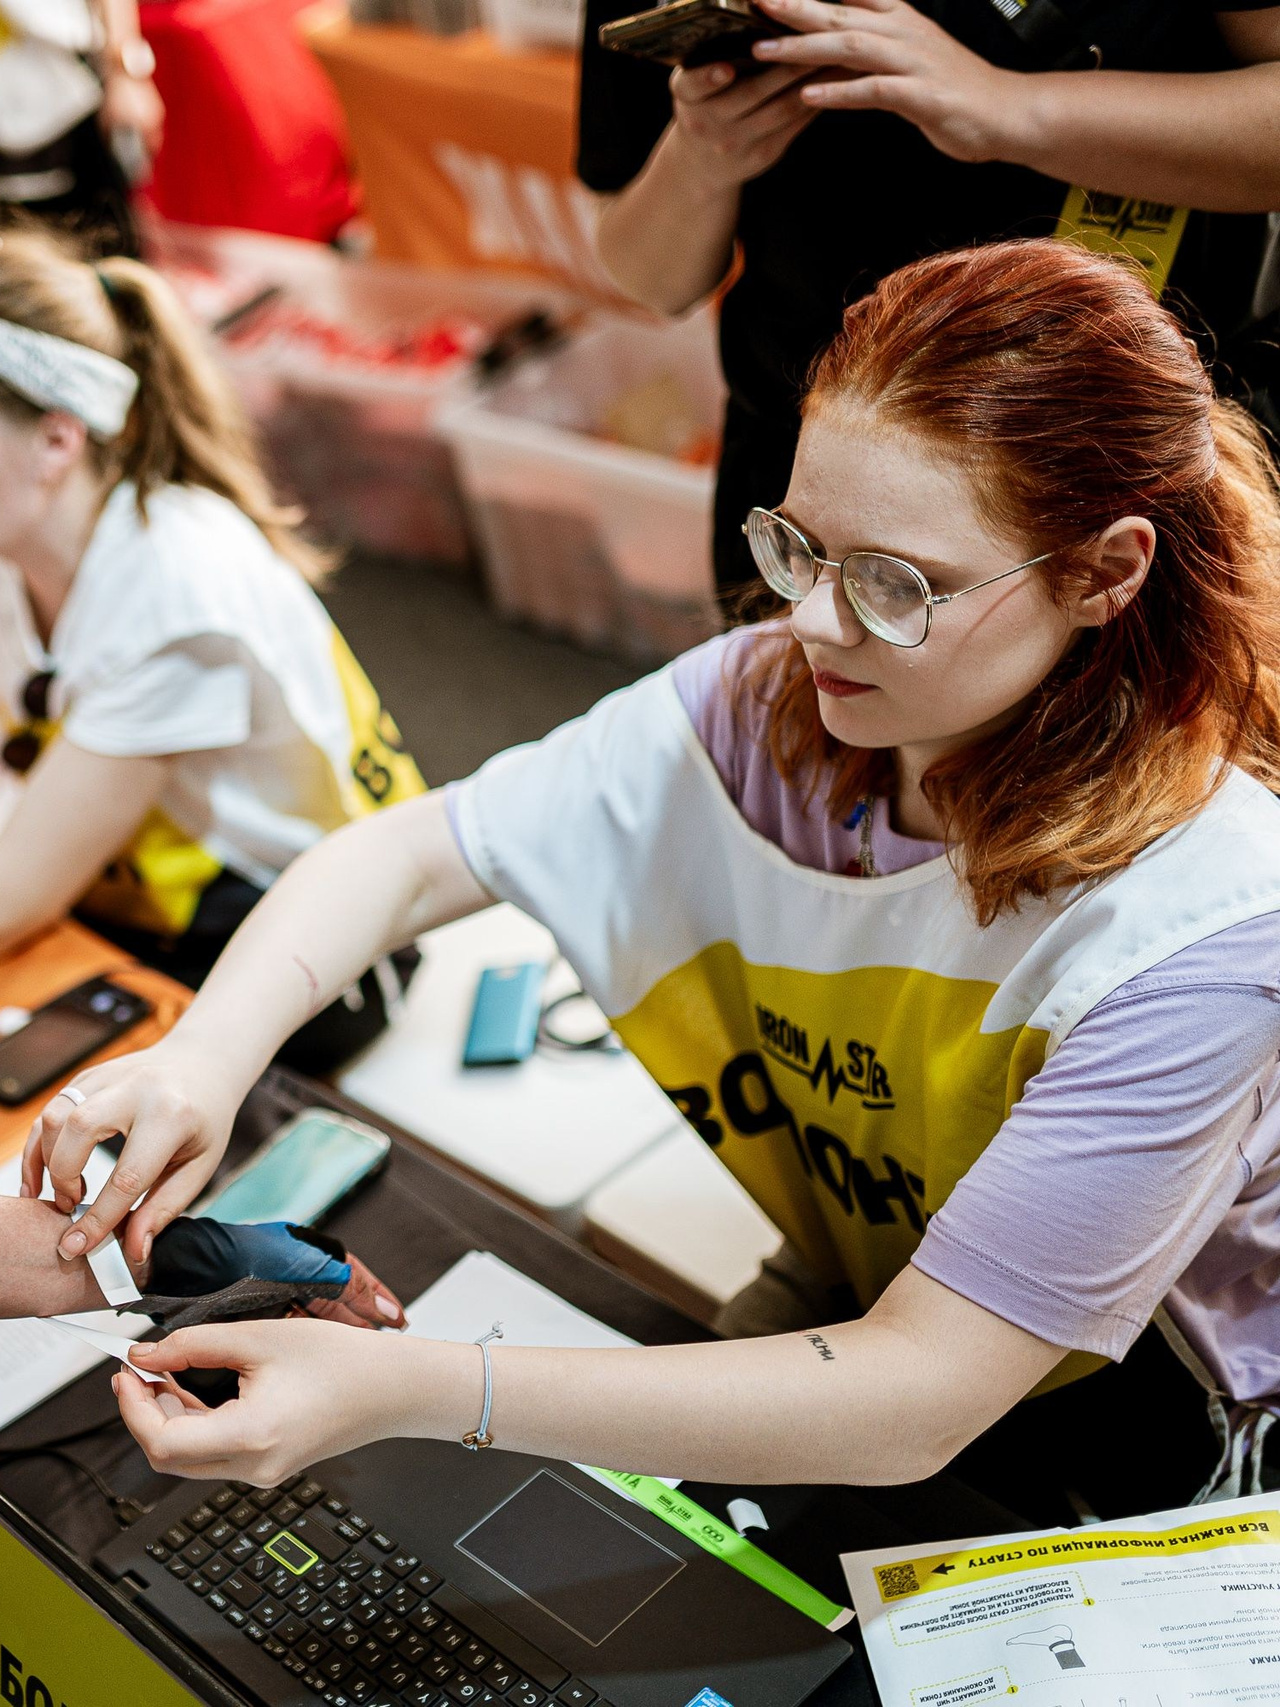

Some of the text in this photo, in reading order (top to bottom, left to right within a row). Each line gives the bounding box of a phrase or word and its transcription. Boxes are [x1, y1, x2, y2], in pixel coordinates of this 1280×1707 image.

[755, 1002, 810, 1064] IRON
[968, 1522, 1270, 1568] ВСЯ ВАЖНАЯ ИНФОРМАЦИЯ ПО СТАРТУ
[920, 1692, 942, 1702] ГОНКИ
[944, 1682, 983, 1697] ОКОНЧАНИЯ
[952, 1687, 986, 1702] СНИМАЙТЕ
